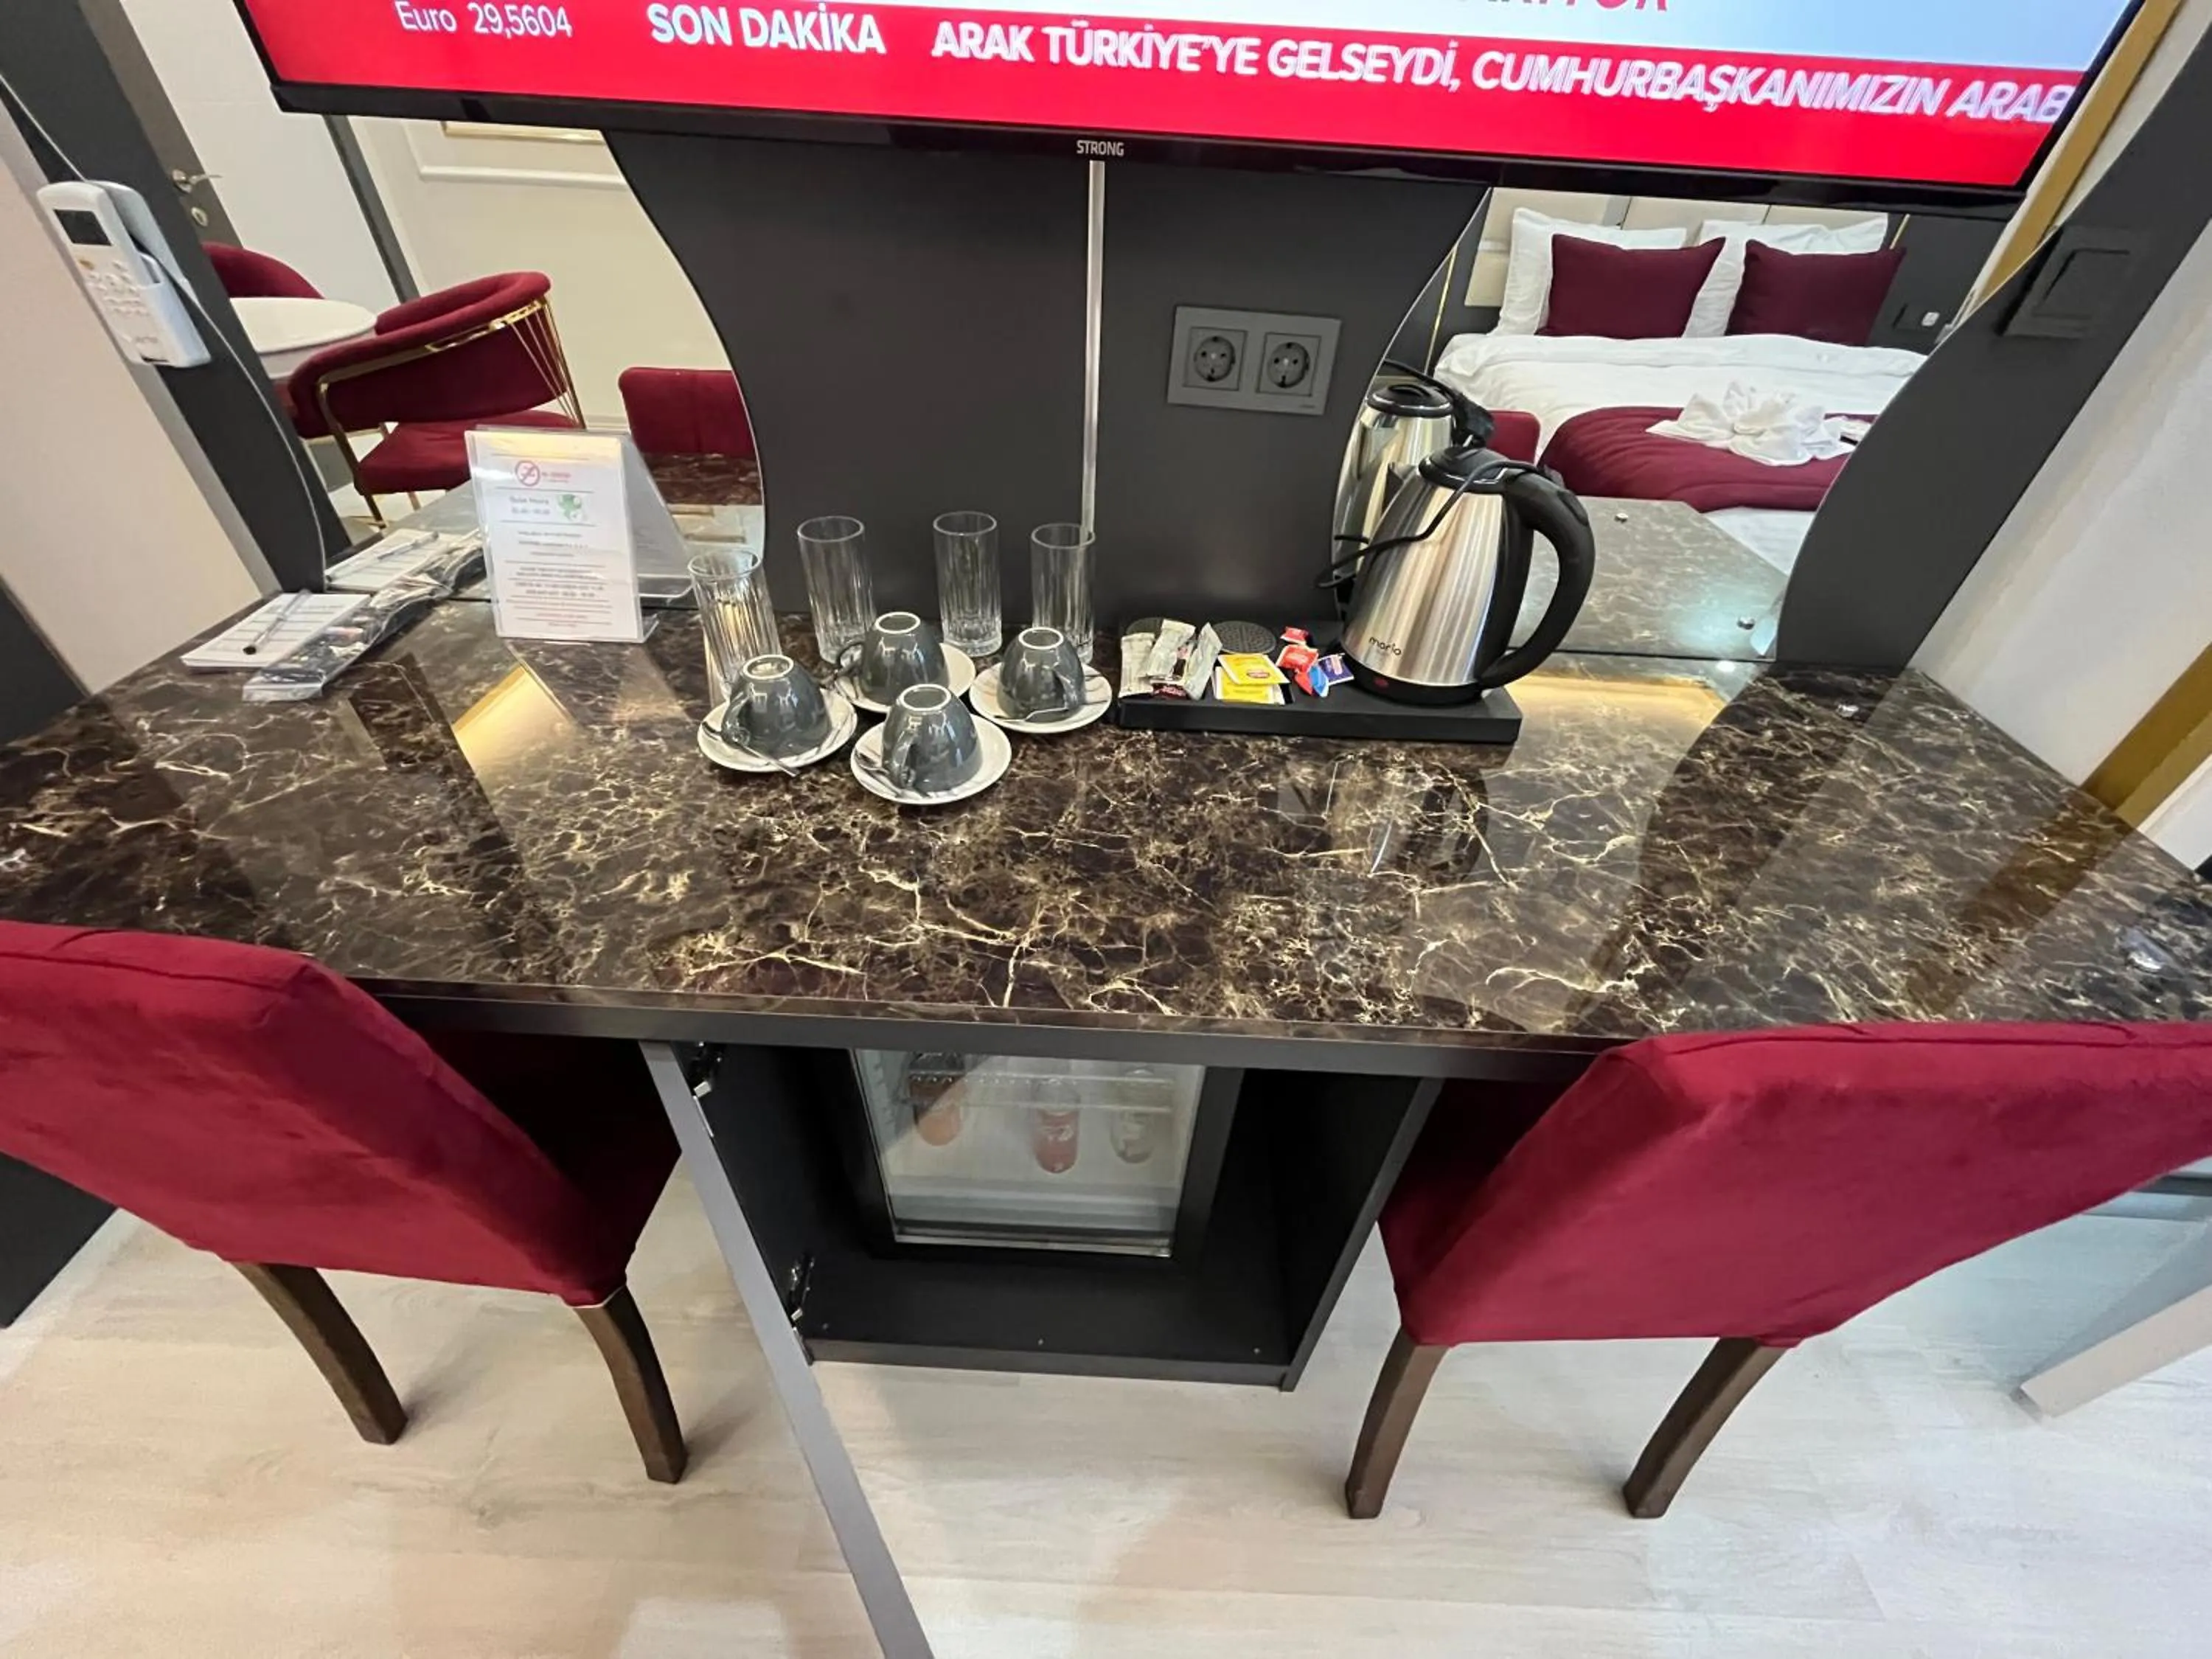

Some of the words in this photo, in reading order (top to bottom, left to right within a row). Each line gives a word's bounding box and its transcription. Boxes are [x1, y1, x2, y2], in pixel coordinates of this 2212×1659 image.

[394, 0, 458, 32] Euro
[467, 2, 573, 38] 29,5604
[647, 3, 732, 46] SON
[739, 1, 887, 55] DAKİKA
[931, 20, 1034, 63] ARAK
[1041, 19, 1262, 75] TÜRKİYE'YE
[1266, 39, 1461, 93] GELSEYDİ,
[1472, 50, 1954, 117] CUMHURBAŞKANIMIZIN
[1076, 139, 1124, 158] STRONG
